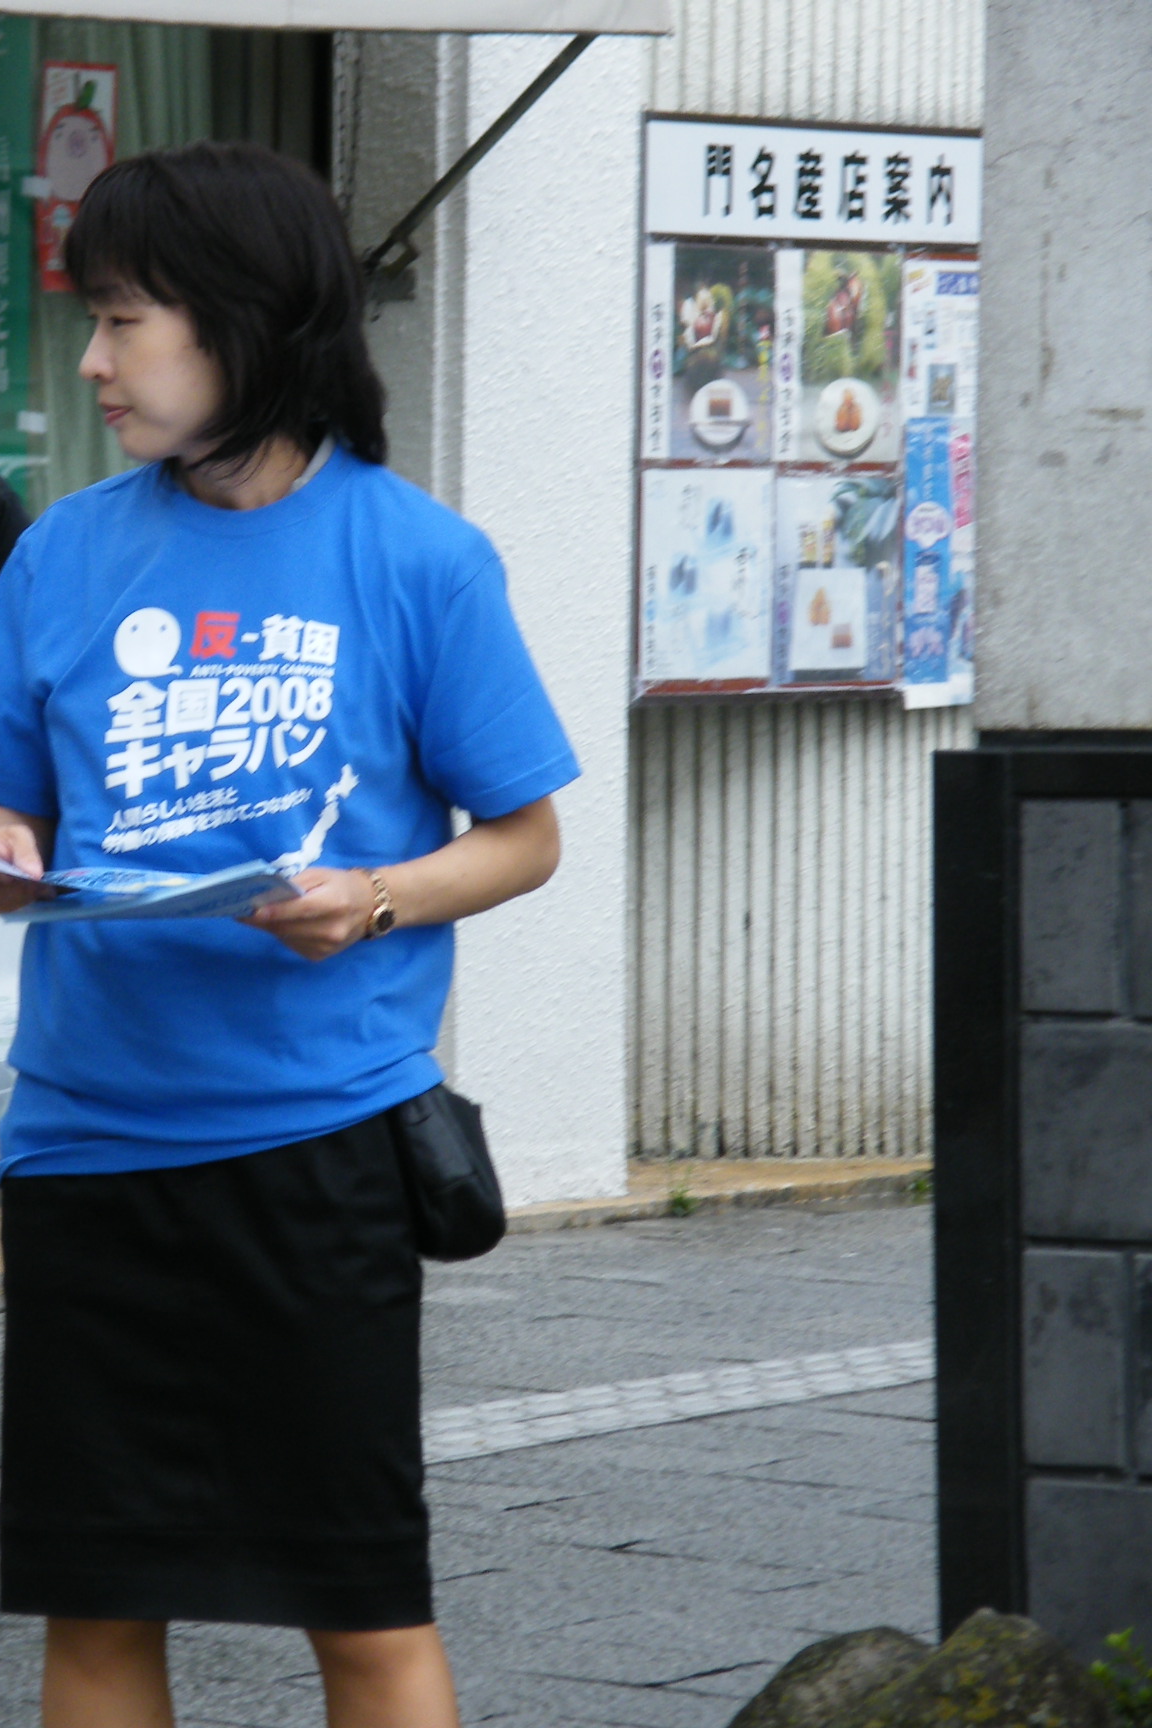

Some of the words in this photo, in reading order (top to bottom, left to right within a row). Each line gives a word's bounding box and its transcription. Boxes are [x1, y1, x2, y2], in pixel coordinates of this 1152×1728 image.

[104, 676, 335, 744] 全国2008
[104, 720, 327, 800] キャラバン
